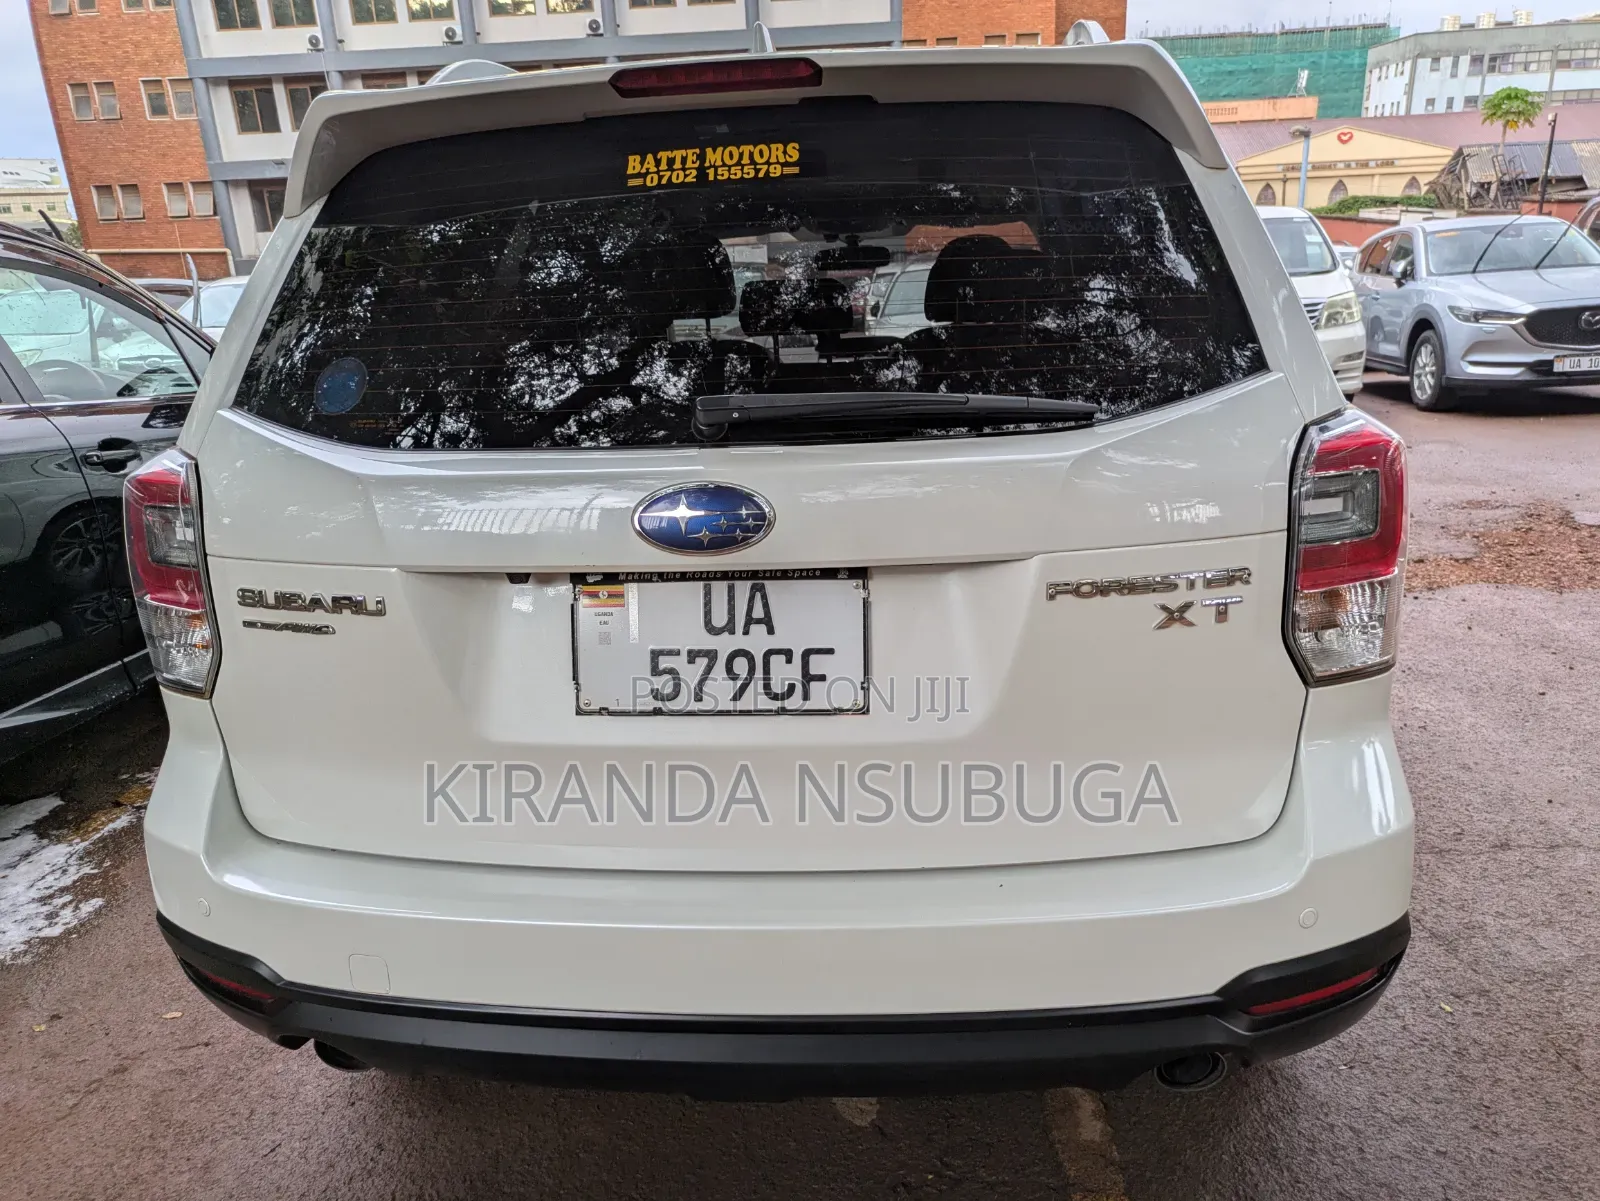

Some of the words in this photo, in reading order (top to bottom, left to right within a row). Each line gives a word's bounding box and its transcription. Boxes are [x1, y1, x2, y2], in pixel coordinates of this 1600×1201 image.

[626, 148, 700, 175] BATTE
[704, 142, 800, 167] MOTORS
[645, 169, 698, 187] 0702
[706, 164, 782, 181] 155579
[1569, 358, 1581, 369] UA
[618, 571, 661, 582] Making
[663, 571, 681, 579] the
[728, 569, 753, 578] Your
[787, 567, 821, 578] Space
[1046, 566, 1252, 601] FORESTER
[236, 587, 387, 617] SUBARU
[702, 582, 776, 636] UA
[649, 647, 836, 702] 579CF
